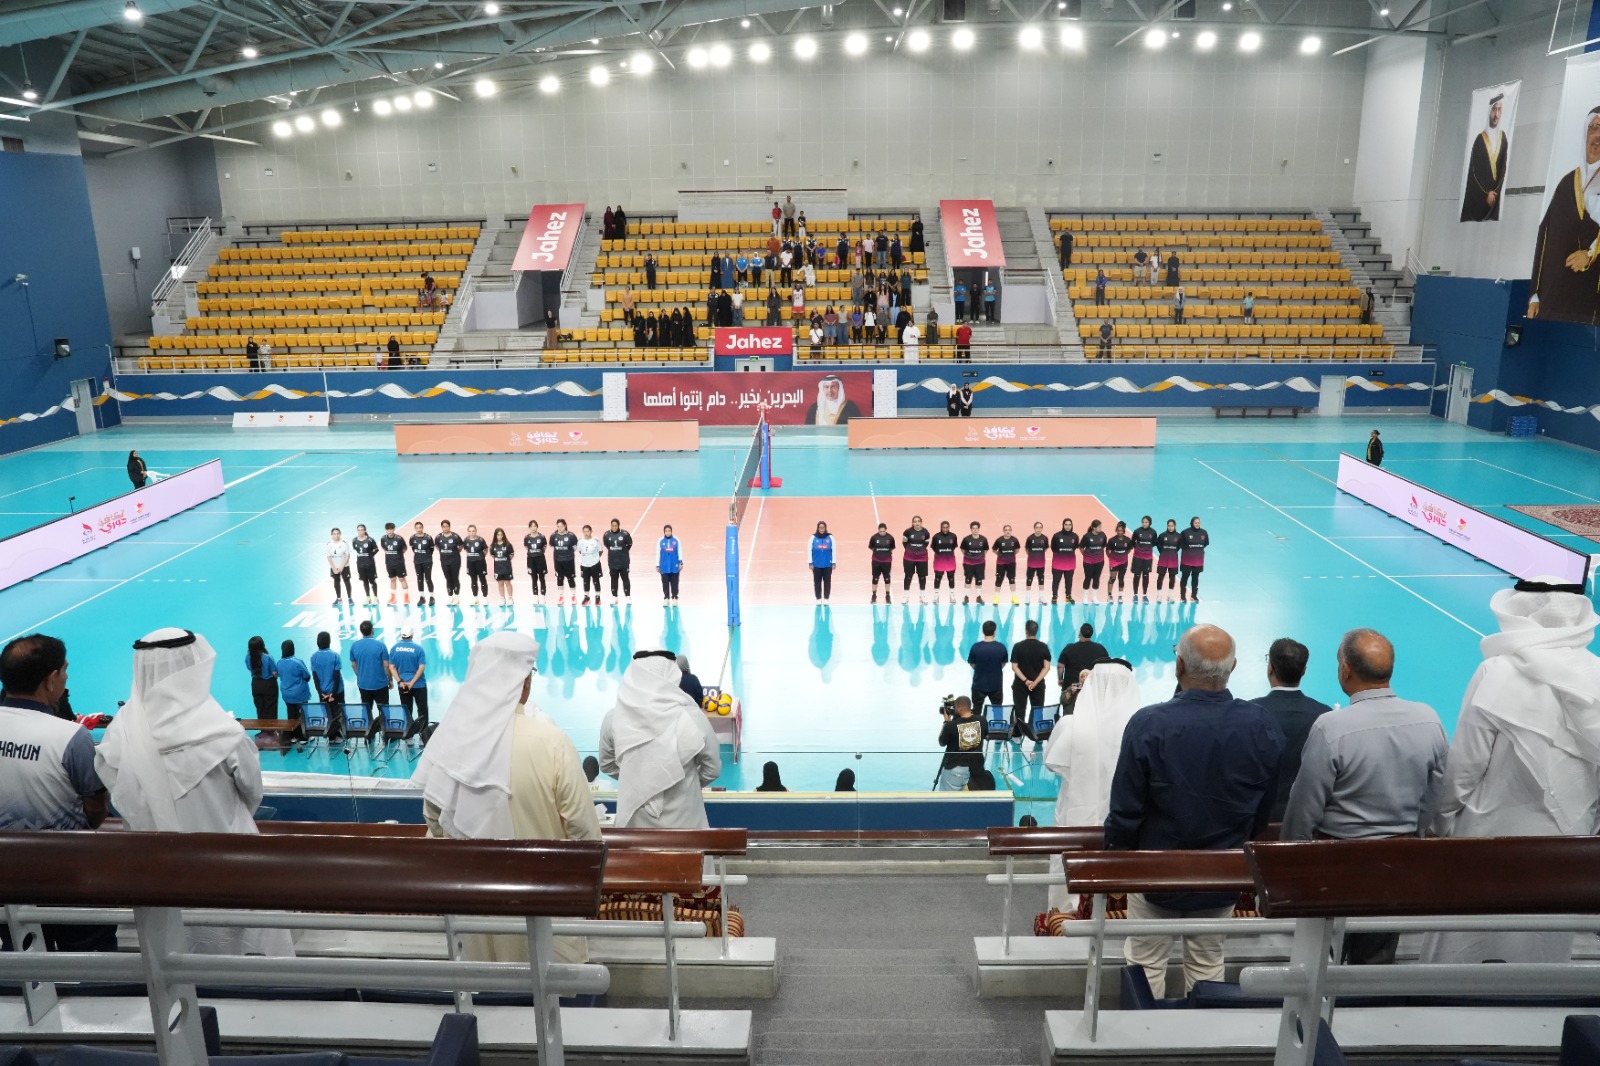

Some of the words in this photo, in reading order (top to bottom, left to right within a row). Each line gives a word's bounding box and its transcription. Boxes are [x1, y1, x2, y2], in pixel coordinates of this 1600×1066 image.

[531, 211, 568, 263] Jahez
[960, 208, 988, 259] Jahez
[725, 333, 783, 350] Jahez
[643, 387, 677, 407] أهلها
[706, 390, 726, 411] دام
